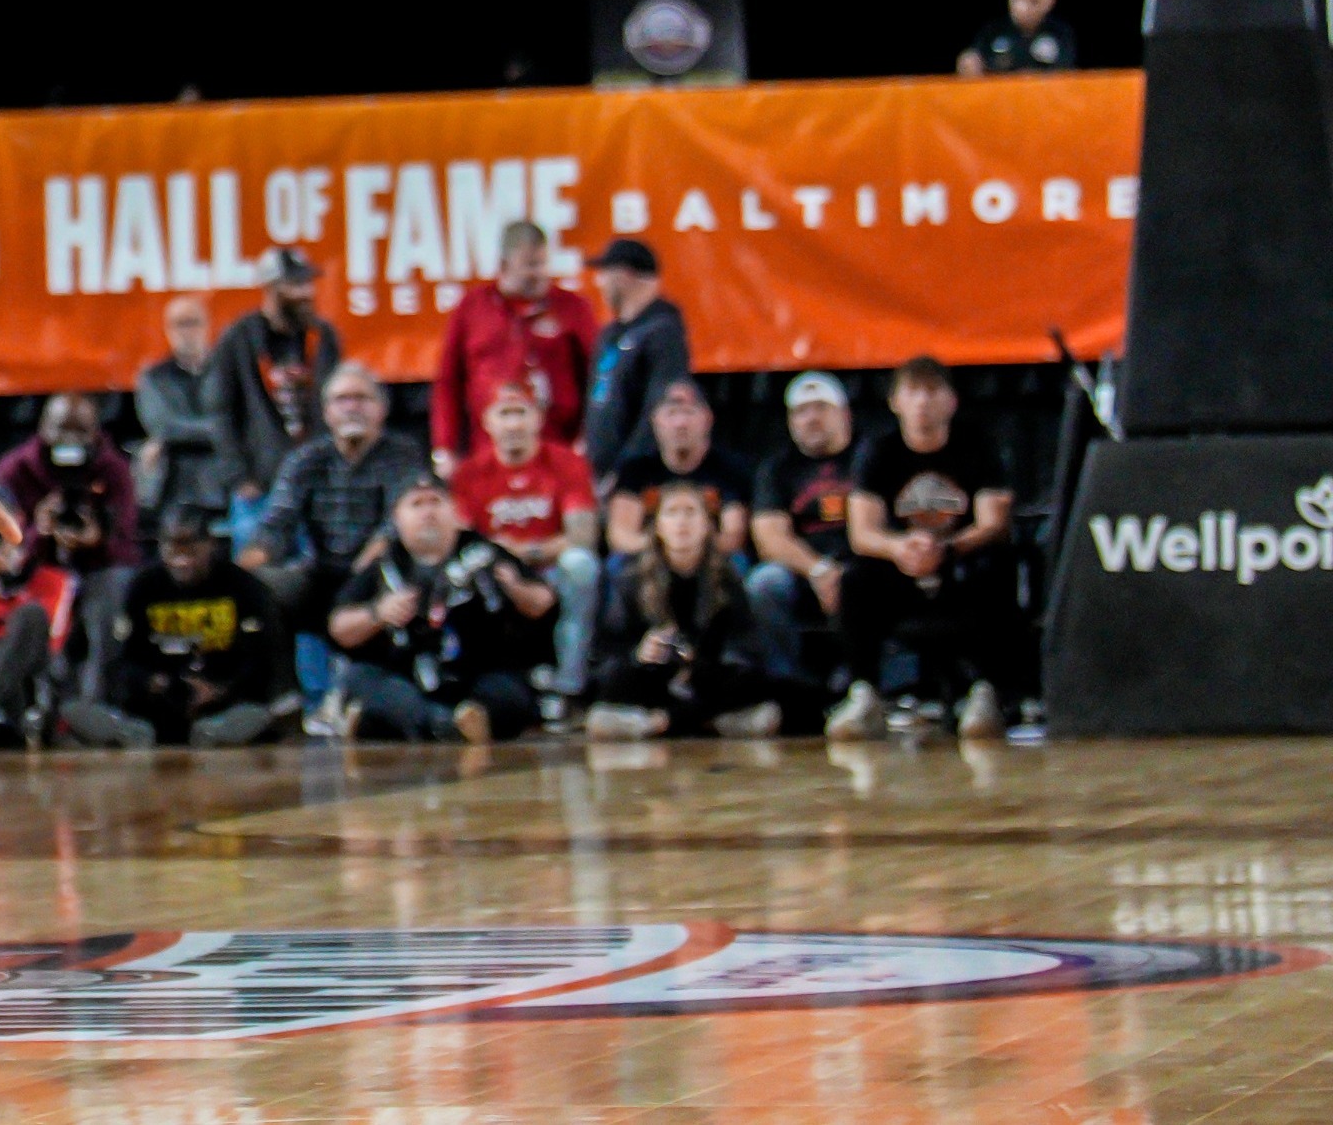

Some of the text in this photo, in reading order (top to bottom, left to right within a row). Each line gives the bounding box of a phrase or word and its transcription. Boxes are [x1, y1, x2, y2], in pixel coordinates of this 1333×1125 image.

[44, 156, 582, 295] HALL OF FAME
[610, 176, 1140, 233] BALTIMORE
